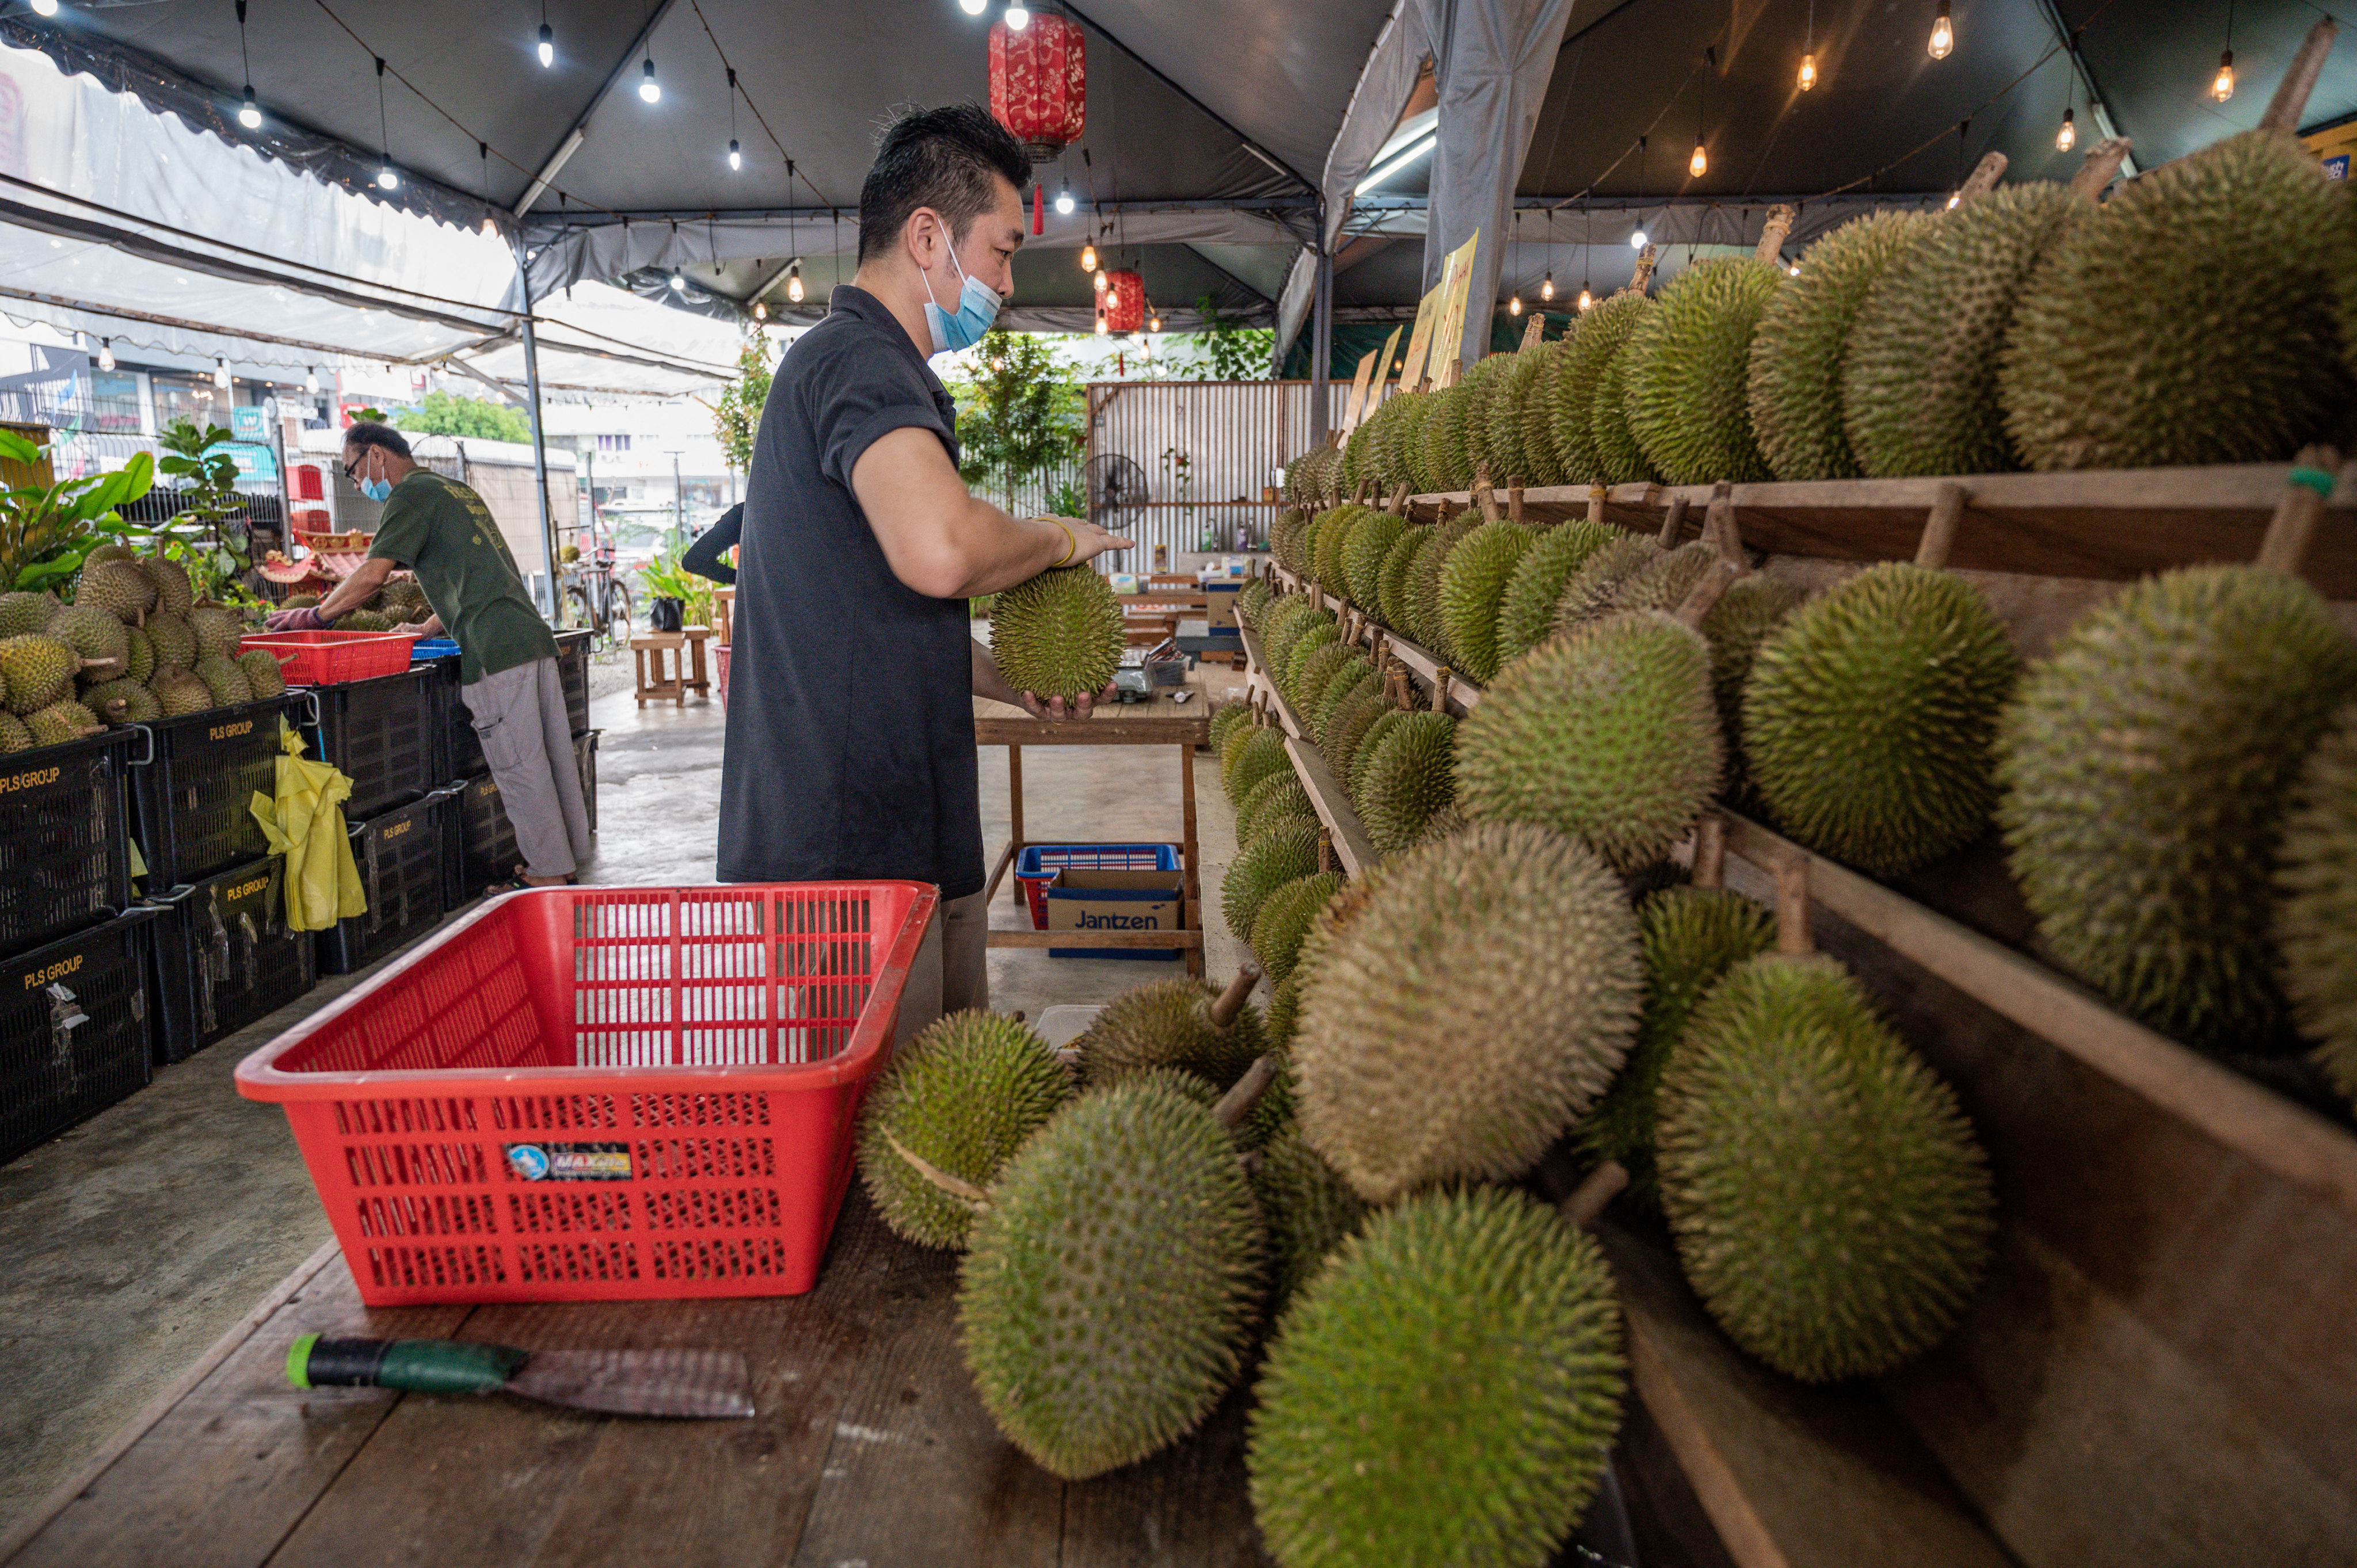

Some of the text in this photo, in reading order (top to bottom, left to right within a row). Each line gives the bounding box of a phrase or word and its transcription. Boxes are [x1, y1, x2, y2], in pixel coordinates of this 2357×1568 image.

[210, 720, 253, 741] PLS GROUP
[0, 767, 60, 793] PLS GROUP
[384, 820, 411, 840] PLS GROUP
[227, 876, 269, 902] PLS GROUP
[1075, 910, 1158, 929] Jantzen
[25, 955, 83, 990] PLS GROUP
